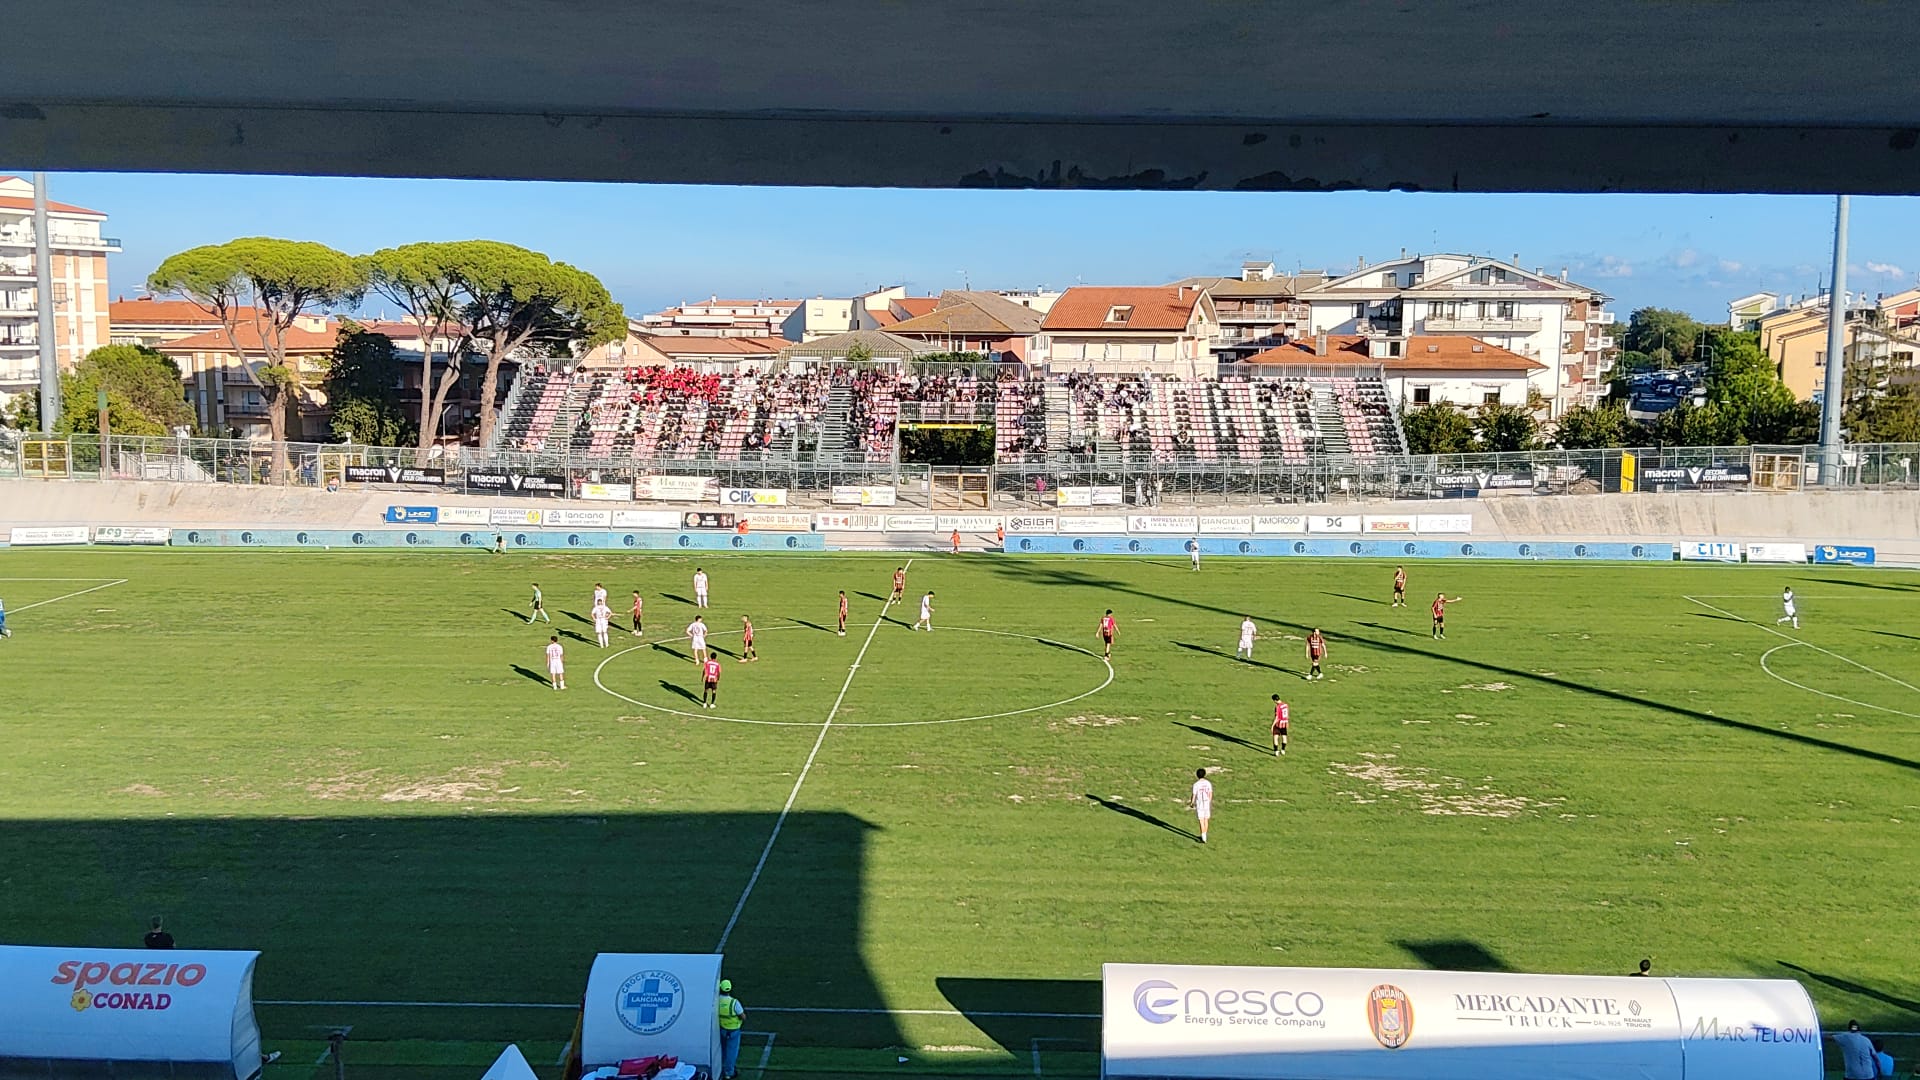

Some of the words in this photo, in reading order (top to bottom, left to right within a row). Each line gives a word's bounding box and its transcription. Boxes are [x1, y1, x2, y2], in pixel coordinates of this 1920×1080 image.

[349, 468, 386, 476] macron
[1645, 470, 1684, 478] macron
[470, 474, 507, 484] macron
[1435, 475, 1473, 484] macron
[565, 511, 604, 519] lanciano
[1259, 517, 1300, 525] AMOROSO
[1023, 518, 1054, 526] GIGA
[51, 961, 207, 991] spazio
[621, 973, 646, 994] CROCE
[650, 972, 680, 994] AZZURRA
[1371, 988, 1405, 1001] LANCIANO
[93, 993, 171, 1010] CONAD
[1454, 993, 1620, 1016] MERCADANTE
[1185, 1015, 1223, 1027] Energy
[1229, 1015, 1268, 1026] Service
[1275, 1016, 1326, 1029] Company
[1505, 1015, 1573, 1028] TRUCK
[1750, 1023, 1812, 1044] TELONI
